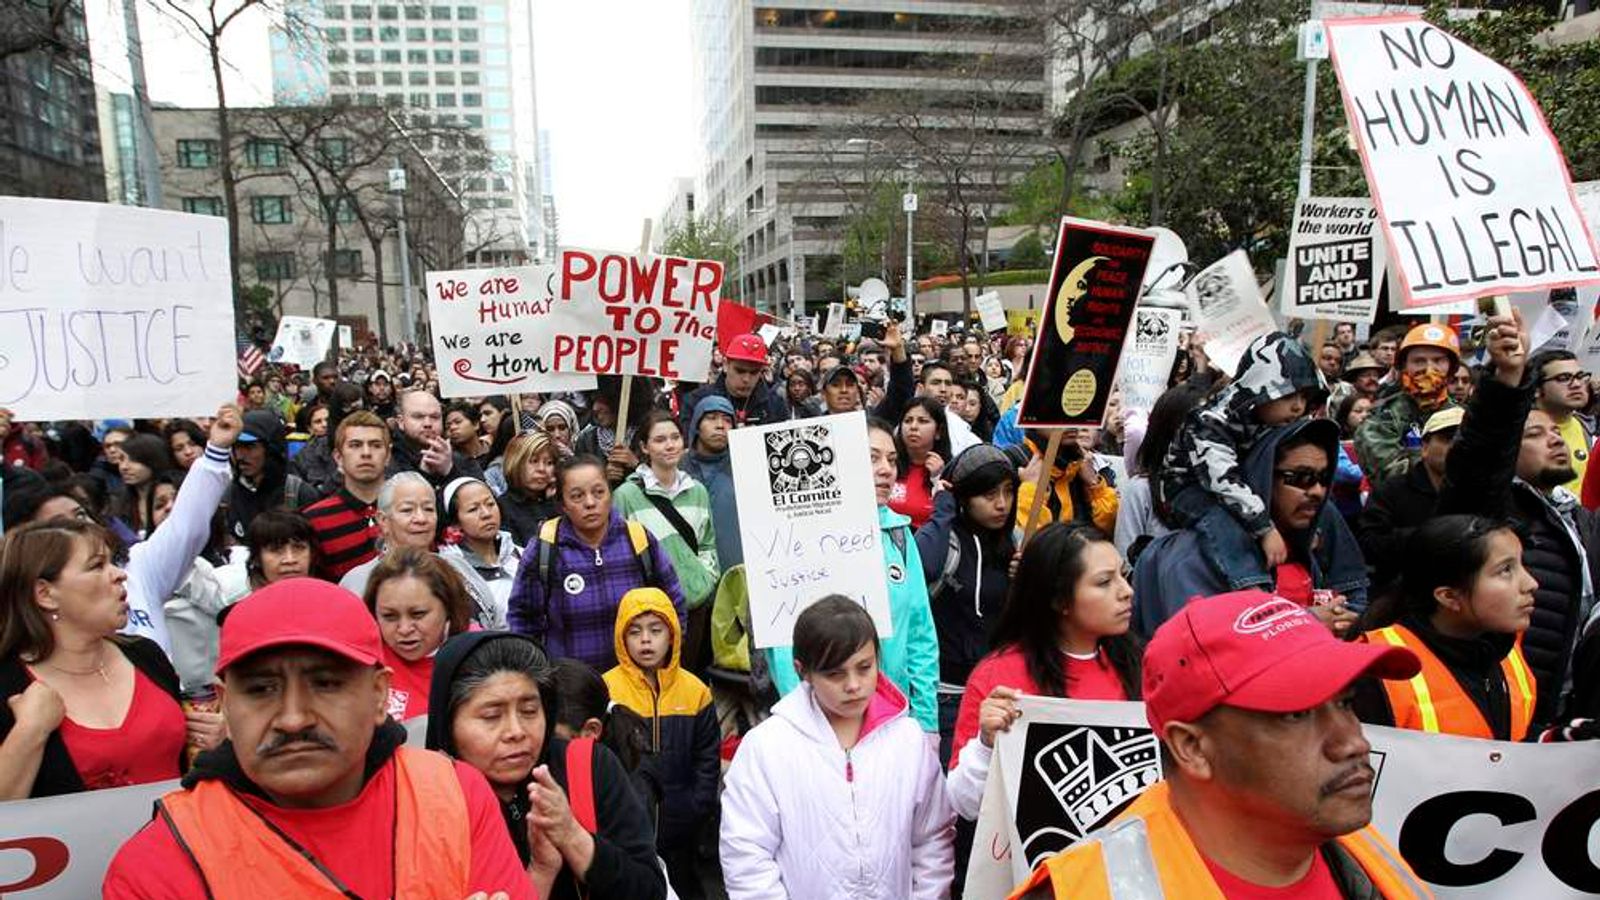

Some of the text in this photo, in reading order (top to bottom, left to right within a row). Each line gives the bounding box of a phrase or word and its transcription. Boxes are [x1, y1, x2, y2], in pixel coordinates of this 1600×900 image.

[1380, 26, 1456, 71] NO
[1354, 80, 1530, 150] HUMAN
[1437, 149, 1496, 199] IS
[1298, 221, 1373, 235] the world
[1299, 203, 1378, 219] Workers o
[0, 217, 210, 292] e want
[1300, 241, 1369, 266] UNITE
[1390, 206, 1599, 291] ILLEGAL
[437, 277, 519, 301] We are
[561, 251, 724, 312] POWER
[1308, 263, 1358, 283] AND
[1300, 280, 1369, 302] FIGHT
[485, 332, 523, 347] are
[606, 306, 714, 341] TO The
[0, 305, 201, 404] JUSTICE
[553, 334, 679, 378] PEOPLE
[773, 487, 842, 507] El Comité
[750, 523, 874, 558] We need
[765, 568, 830, 589] Justice
